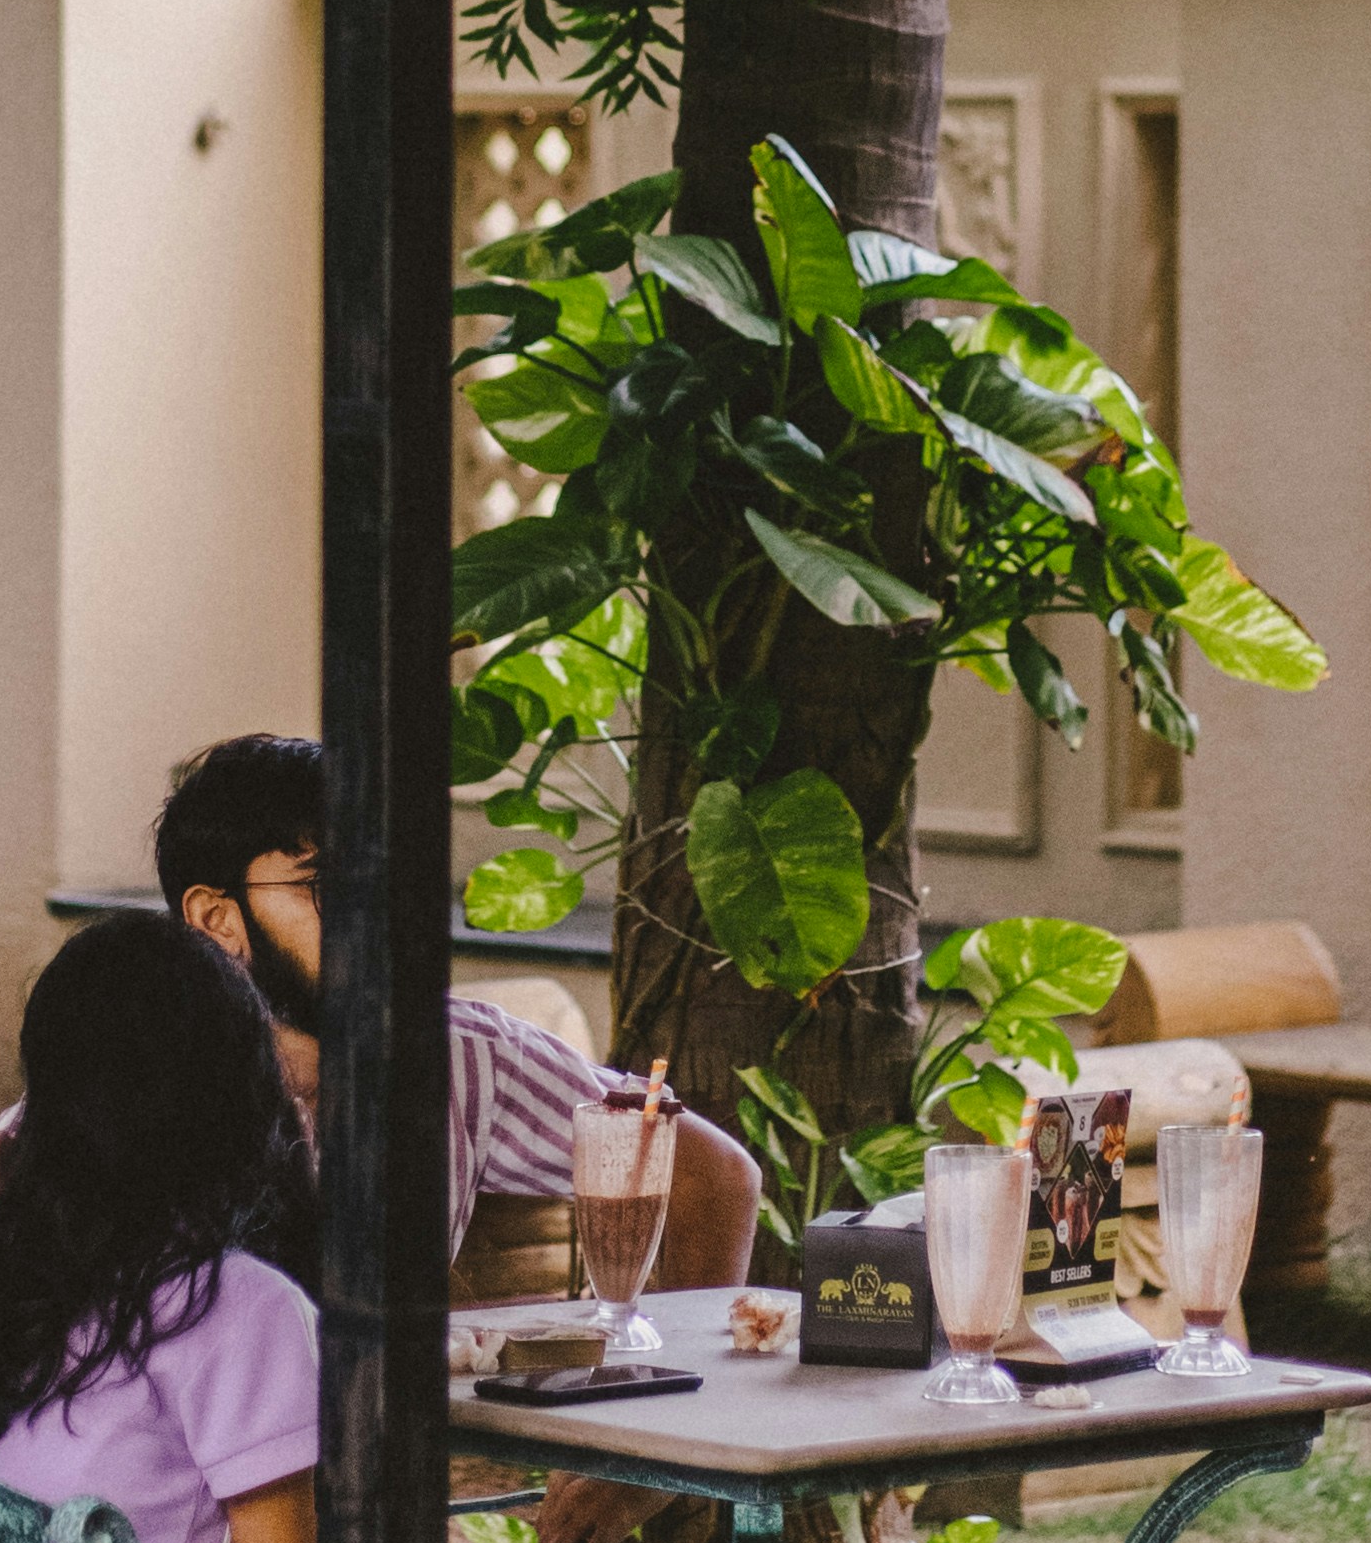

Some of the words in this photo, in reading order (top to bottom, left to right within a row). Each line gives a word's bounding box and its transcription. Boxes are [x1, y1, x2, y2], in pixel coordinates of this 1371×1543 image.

[1050, 1268, 1067, 1284] BEST
[1067, 1264, 1092, 1281] SELLERS
[816, 1304, 833, 1313] THE
